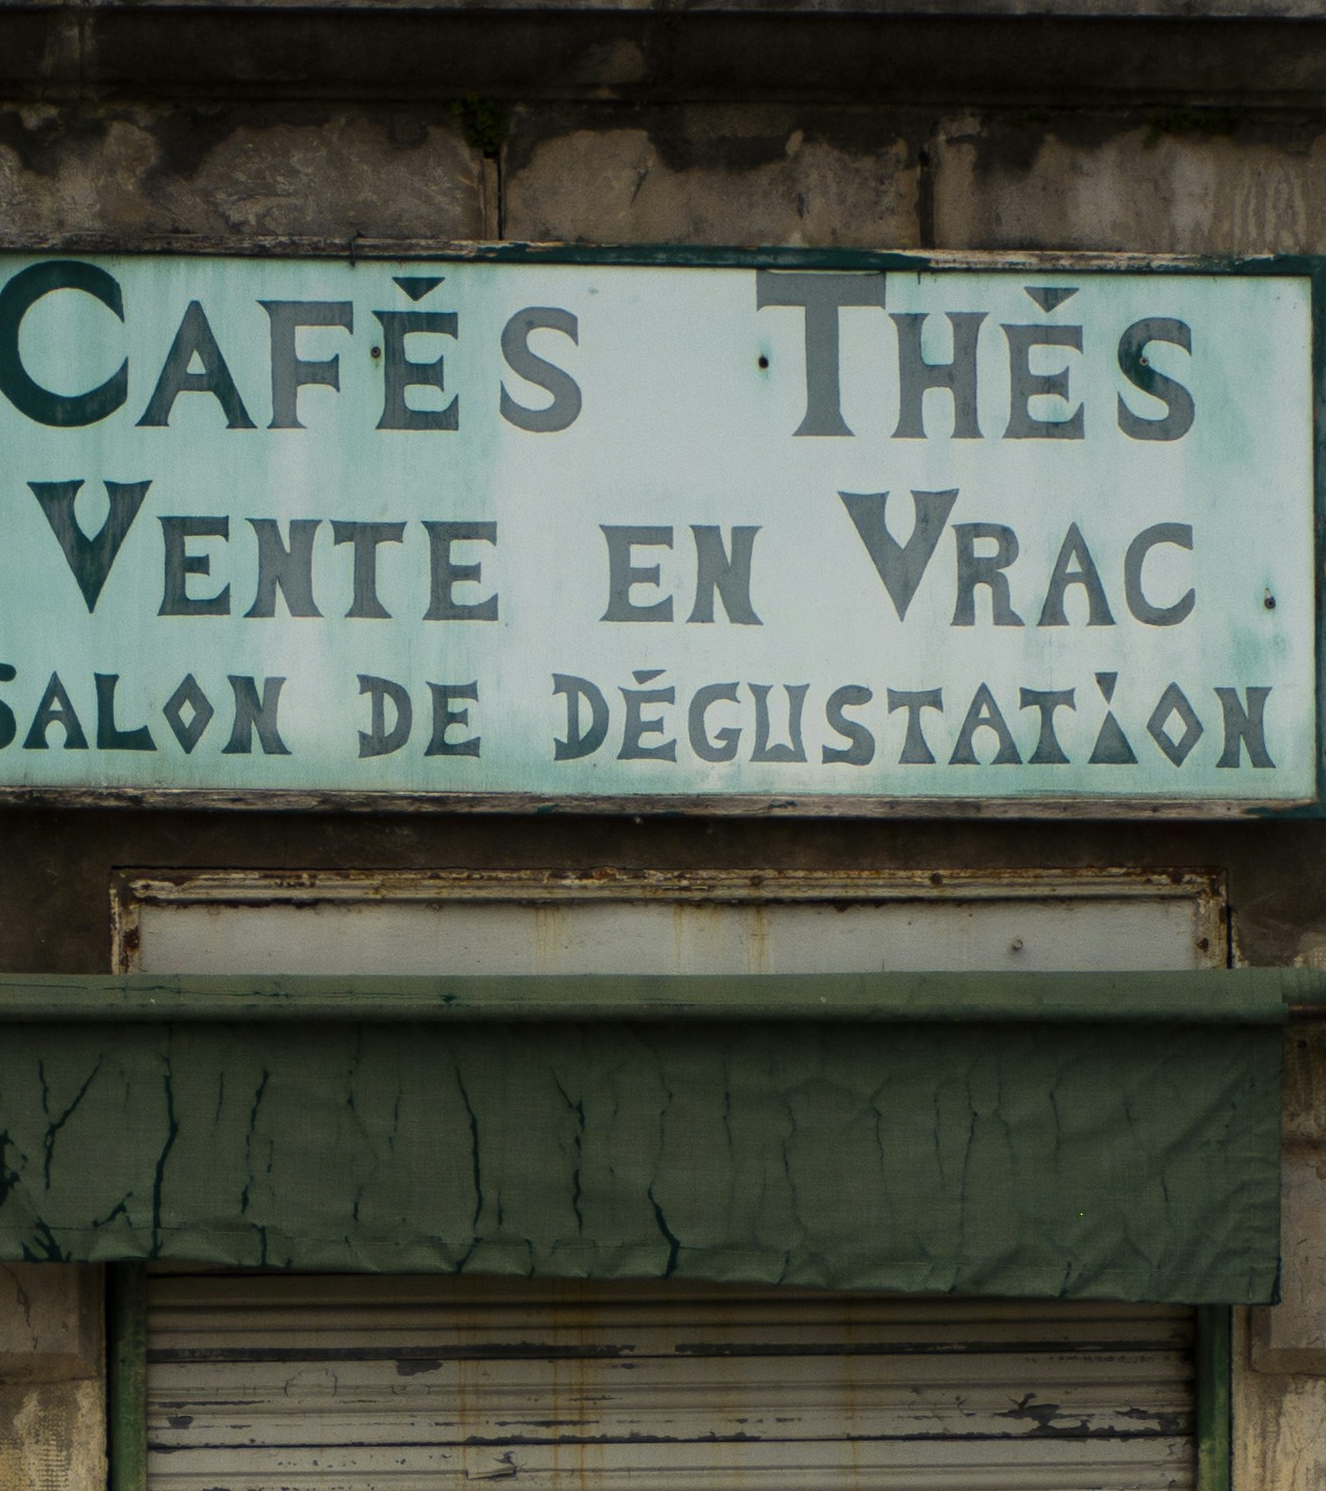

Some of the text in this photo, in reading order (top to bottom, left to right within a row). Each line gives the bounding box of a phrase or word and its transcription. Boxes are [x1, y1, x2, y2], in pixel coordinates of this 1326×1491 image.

[27, 479, 1197, 627] VENTE EN VRAC
[357, 673, 482, 759] DE
[551, 669, 1276, 770] DÉGUSTATION
